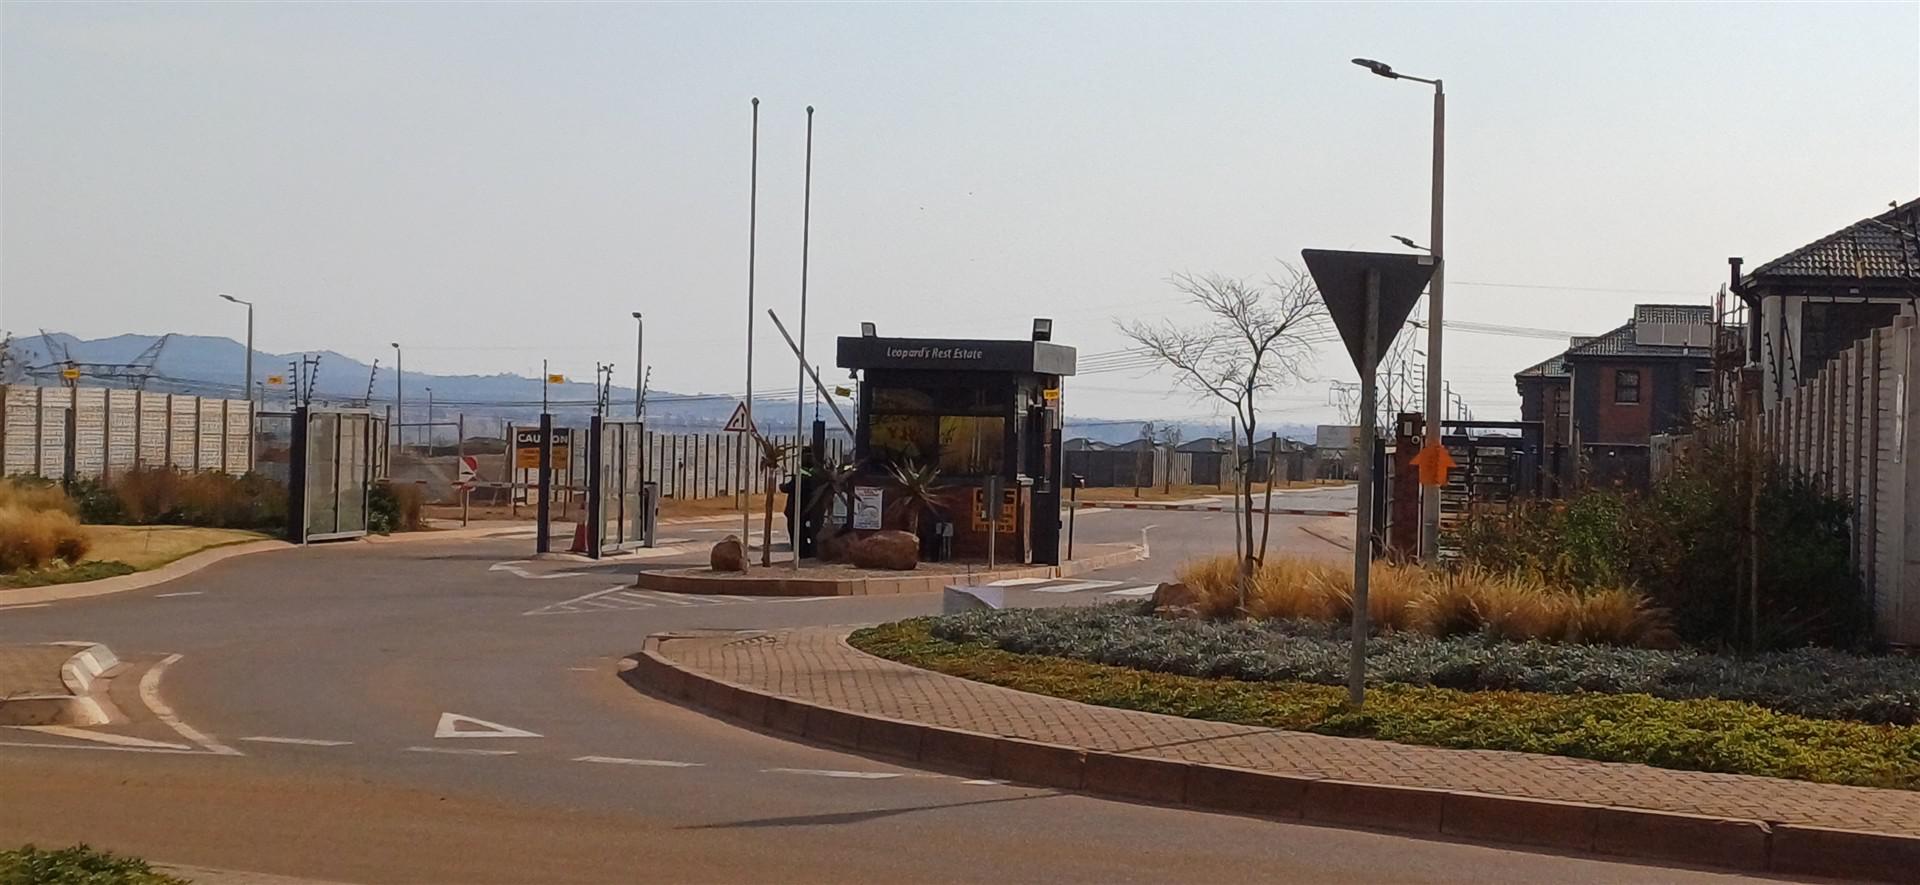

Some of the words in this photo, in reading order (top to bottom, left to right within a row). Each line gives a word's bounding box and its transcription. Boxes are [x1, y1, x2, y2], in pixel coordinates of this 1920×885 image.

[931, 347, 952, 359] Rest
[952, 347, 983, 359] Estate
[518, 433, 568, 444] CAUON
